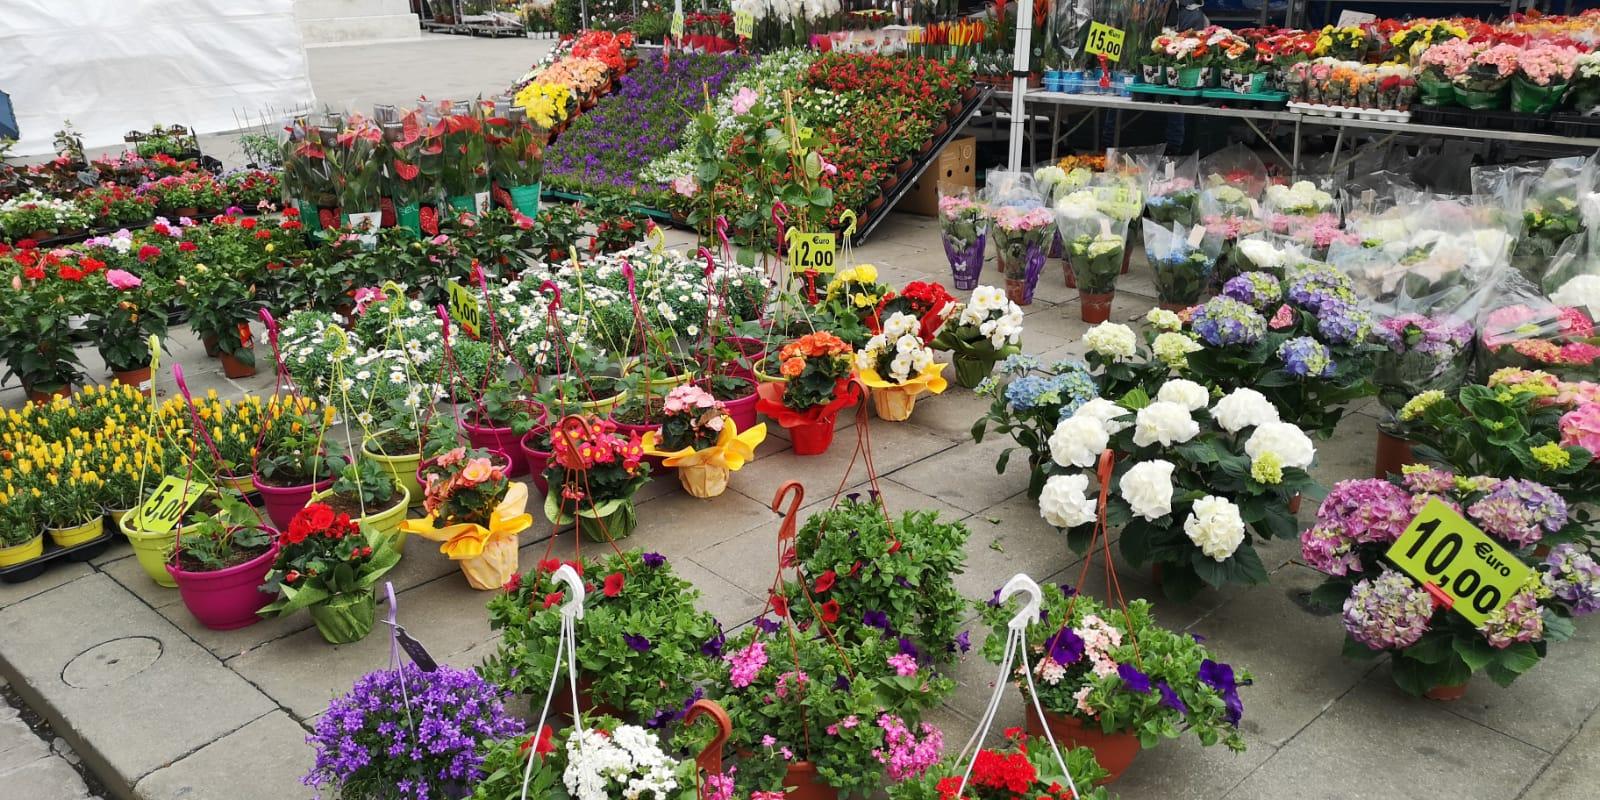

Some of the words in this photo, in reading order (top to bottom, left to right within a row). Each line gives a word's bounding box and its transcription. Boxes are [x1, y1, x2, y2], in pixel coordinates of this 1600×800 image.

[1090, 29, 1121, 56] 15,00
[795, 240, 834, 270] 12,00
[452, 287, 477, 327] 4,00
[144, 483, 189, 524] 5,00
[1405, 518, 1502, 615] 10,00
